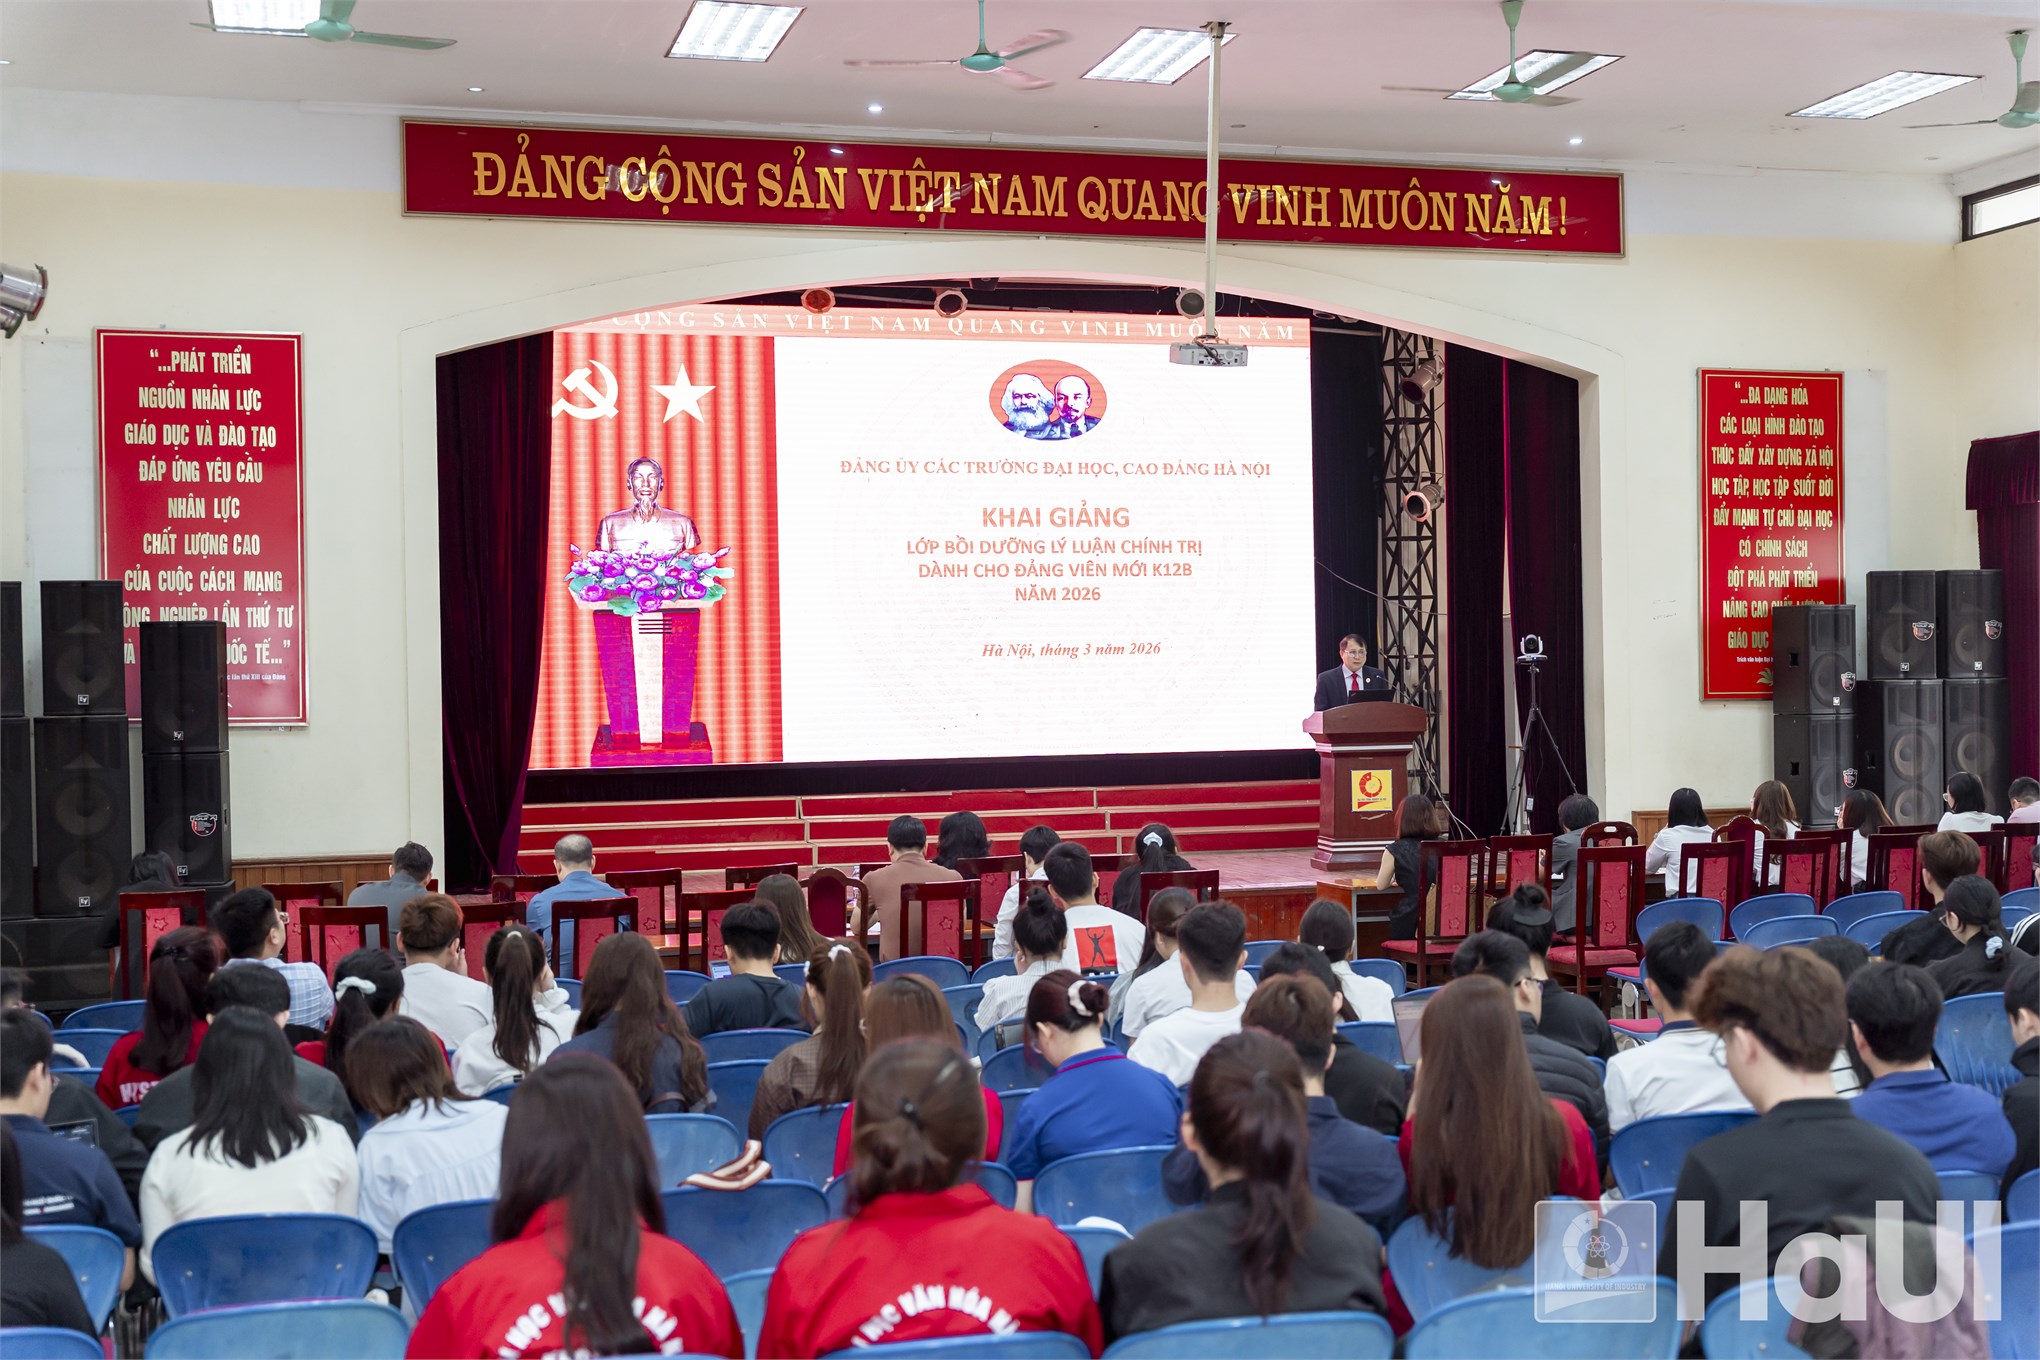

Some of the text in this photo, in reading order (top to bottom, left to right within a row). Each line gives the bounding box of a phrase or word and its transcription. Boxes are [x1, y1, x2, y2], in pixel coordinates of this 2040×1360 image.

[472, 133, 606, 201] ĐẢNG
[619, 145, 747, 215] CỘNG
[758, 145, 848, 210] SẢN
[857, 157, 959, 222] VIỆT
[970, 172, 1068, 218] NAM
[1228, 182, 1332, 227] VINH
[1339, 177, 1457, 232] MUÔN
[713, 308, 768, 329] SẢN
[785, 310, 854, 334] VIỆT
[870, 316, 931, 332] NAM
[948, 317, 1046, 336] QUANG
[1062, 320, 1130, 336] VINH
[1239, 321, 1293, 340] NĂM
[212, 345, 251, 374] TRIỂN
[139, 380, 262, 415] NGUỒN NHÂN LỰC
[1764, 387, 1788, 408] DẠNG
[1791, 383, 1808, 405] HÓA
[124, 419, 276, 451] GIÁO DỤC VÀ ĐÀO TẠO
[1720, 412, 1824, 439] CÁC LOẠI HÌNH ĐÀO TẠO
[139, 452, 263, 483] ĐÁP ỨNG YÊU CẦU
[840, 458, 891, 474] ĐẢNG
[895, 457, 923, 474] ỦY
[925, 459, 963, 475] CÁC
[967, 459, 1040, 475] TRƯỜNG
[1042, 462, 1074, 477] ĐẠI
[1078, 462, 1119, 478] HỌC,
[1122, 462, 1159, 475] CAO
[1214, 459, 1238, 476] HÀ
[1241, 461, 1271, 479] NỘI
[1712, 441, 1834, 470] THÚC ĐẨY XÂY DỰNG XÃ HỘI
[1712, 473, 1834, 500] HỌC TẬP, HỌC TẬP SUỐT ĐỜI
[168, 493, 240, 523] NHÂN LỰC
[982, 500, 1131, 528] KHAI GIẢNG
[1713, 501, 1833, 531] ĐẨY MẠNH TỰ CHỦ ĐẠI HỌC
[143, 527, 260, 559] CHẤT LƯỢNG CAO
[907, 535, 1203, 558] LỚP BỒI DƯỠNG LÝ LUẬN CHÍNH TRỊ
[1739, 536, 1808, 557] CÓ CHÍNH SÁCH
[124, 564, 283, 596] CỦA CUỘC CÁCH MẠNG
[918, 558, 1193, 578] DÀNH CHO ĐẢNG VIÊN MỚI K12B
[1728, 562, 1818, 591] ĐỘT PHÁ PHÁT TRIỂN
[1015, 584, 1101, 602] NĂM 2026
[123, 602, 150, 628] ÔNG
[245, 600, 271, 628] THỨ
[276, 605, 294, 628] TƯ
[1723, 597, 1768, 618] NÂNG CAO
[982, 643, 1161, 660] Hà Nội, tháng 3 năm 2026
[1728, 627, 1769, 652] GIÁO DỤC
